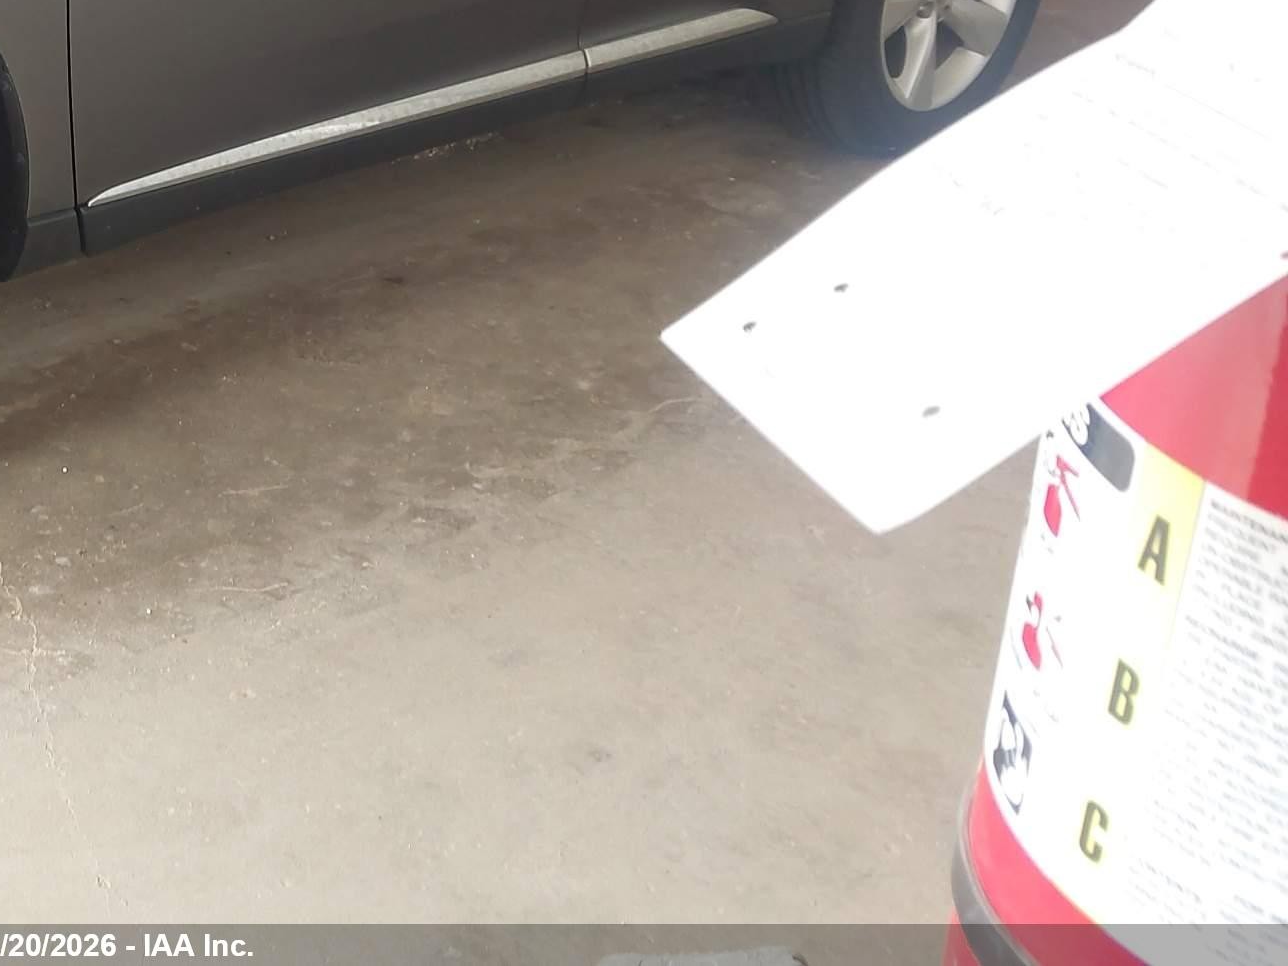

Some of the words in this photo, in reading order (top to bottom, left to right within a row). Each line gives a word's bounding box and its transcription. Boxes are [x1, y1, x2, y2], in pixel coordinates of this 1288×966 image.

[1138, 514, 1170, 586] A
[1108, 657, 1140, 726] B
[1079, 800, 1109, 863] C
